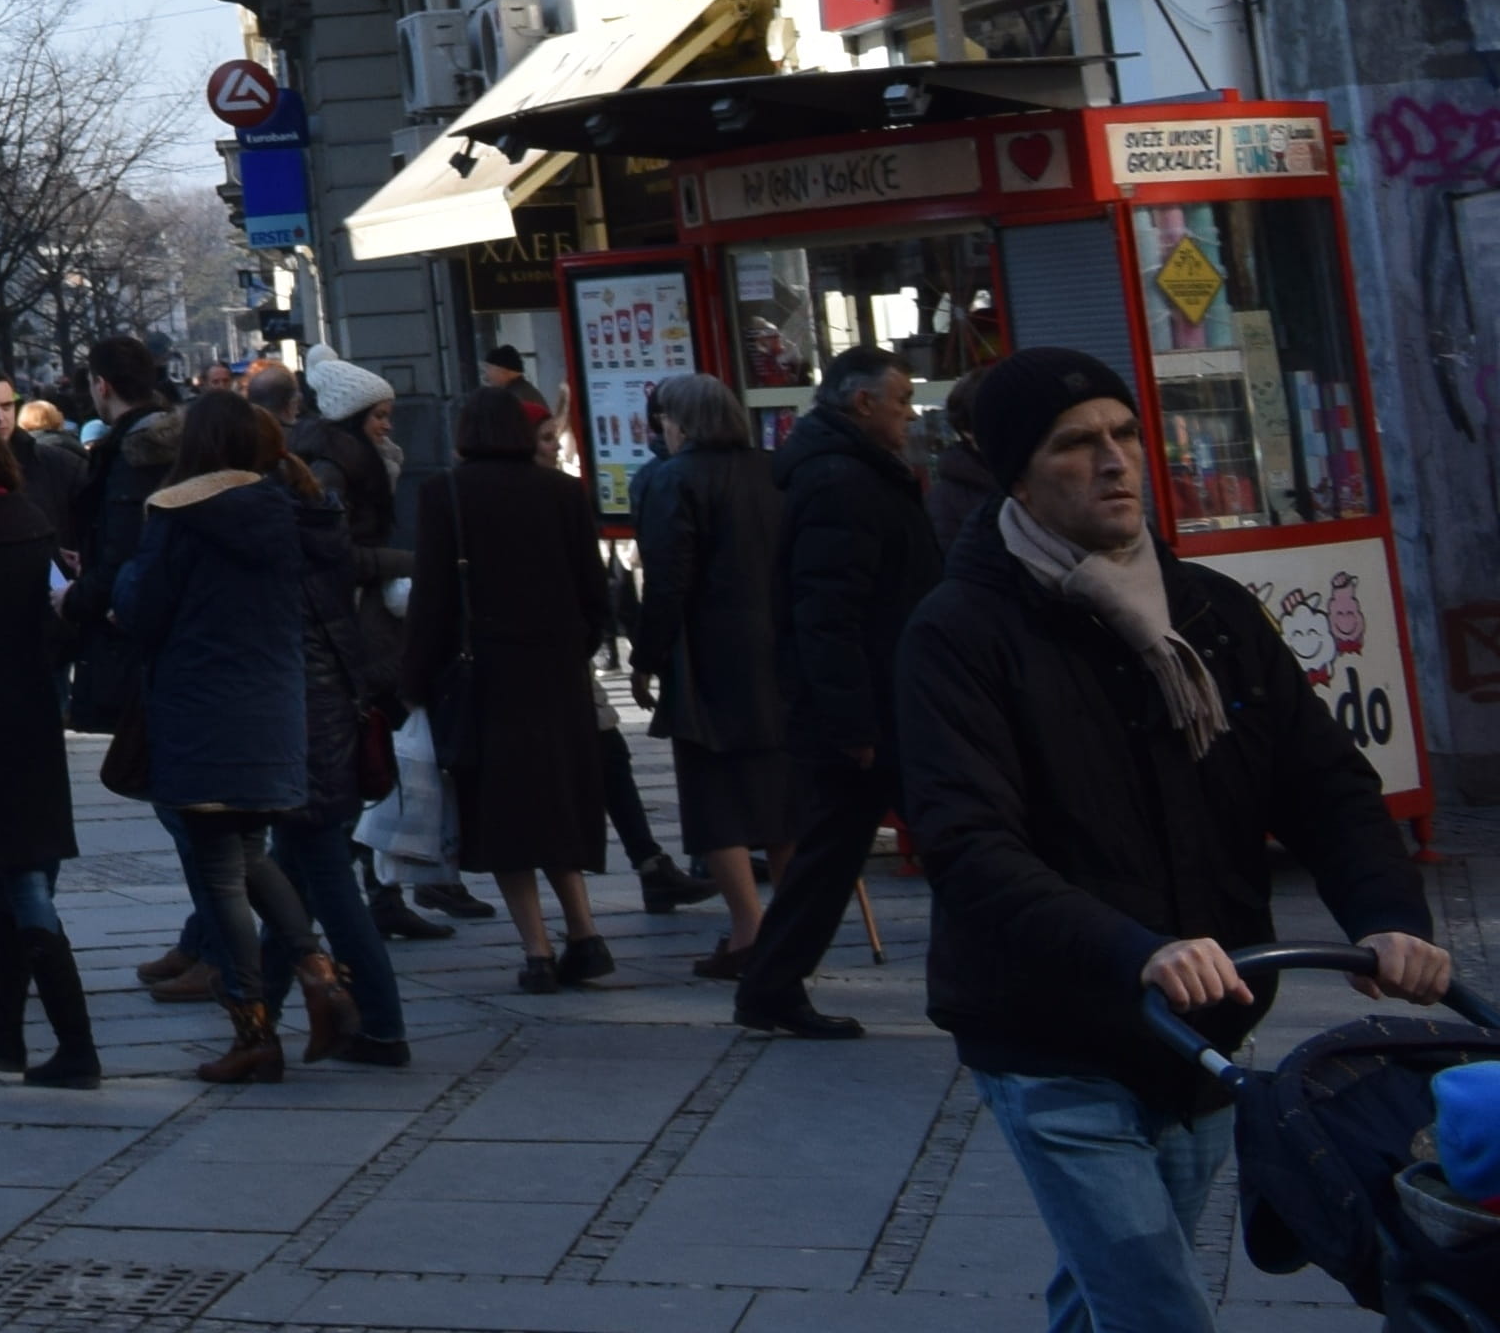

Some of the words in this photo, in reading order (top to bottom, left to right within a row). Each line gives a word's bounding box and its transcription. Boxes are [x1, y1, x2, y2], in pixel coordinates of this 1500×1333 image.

[245, 131, 300, 145] Eurobank
[251, 228, 292, 246] ERSTE
[479, 232, 573, 263] ХЛЕБ
